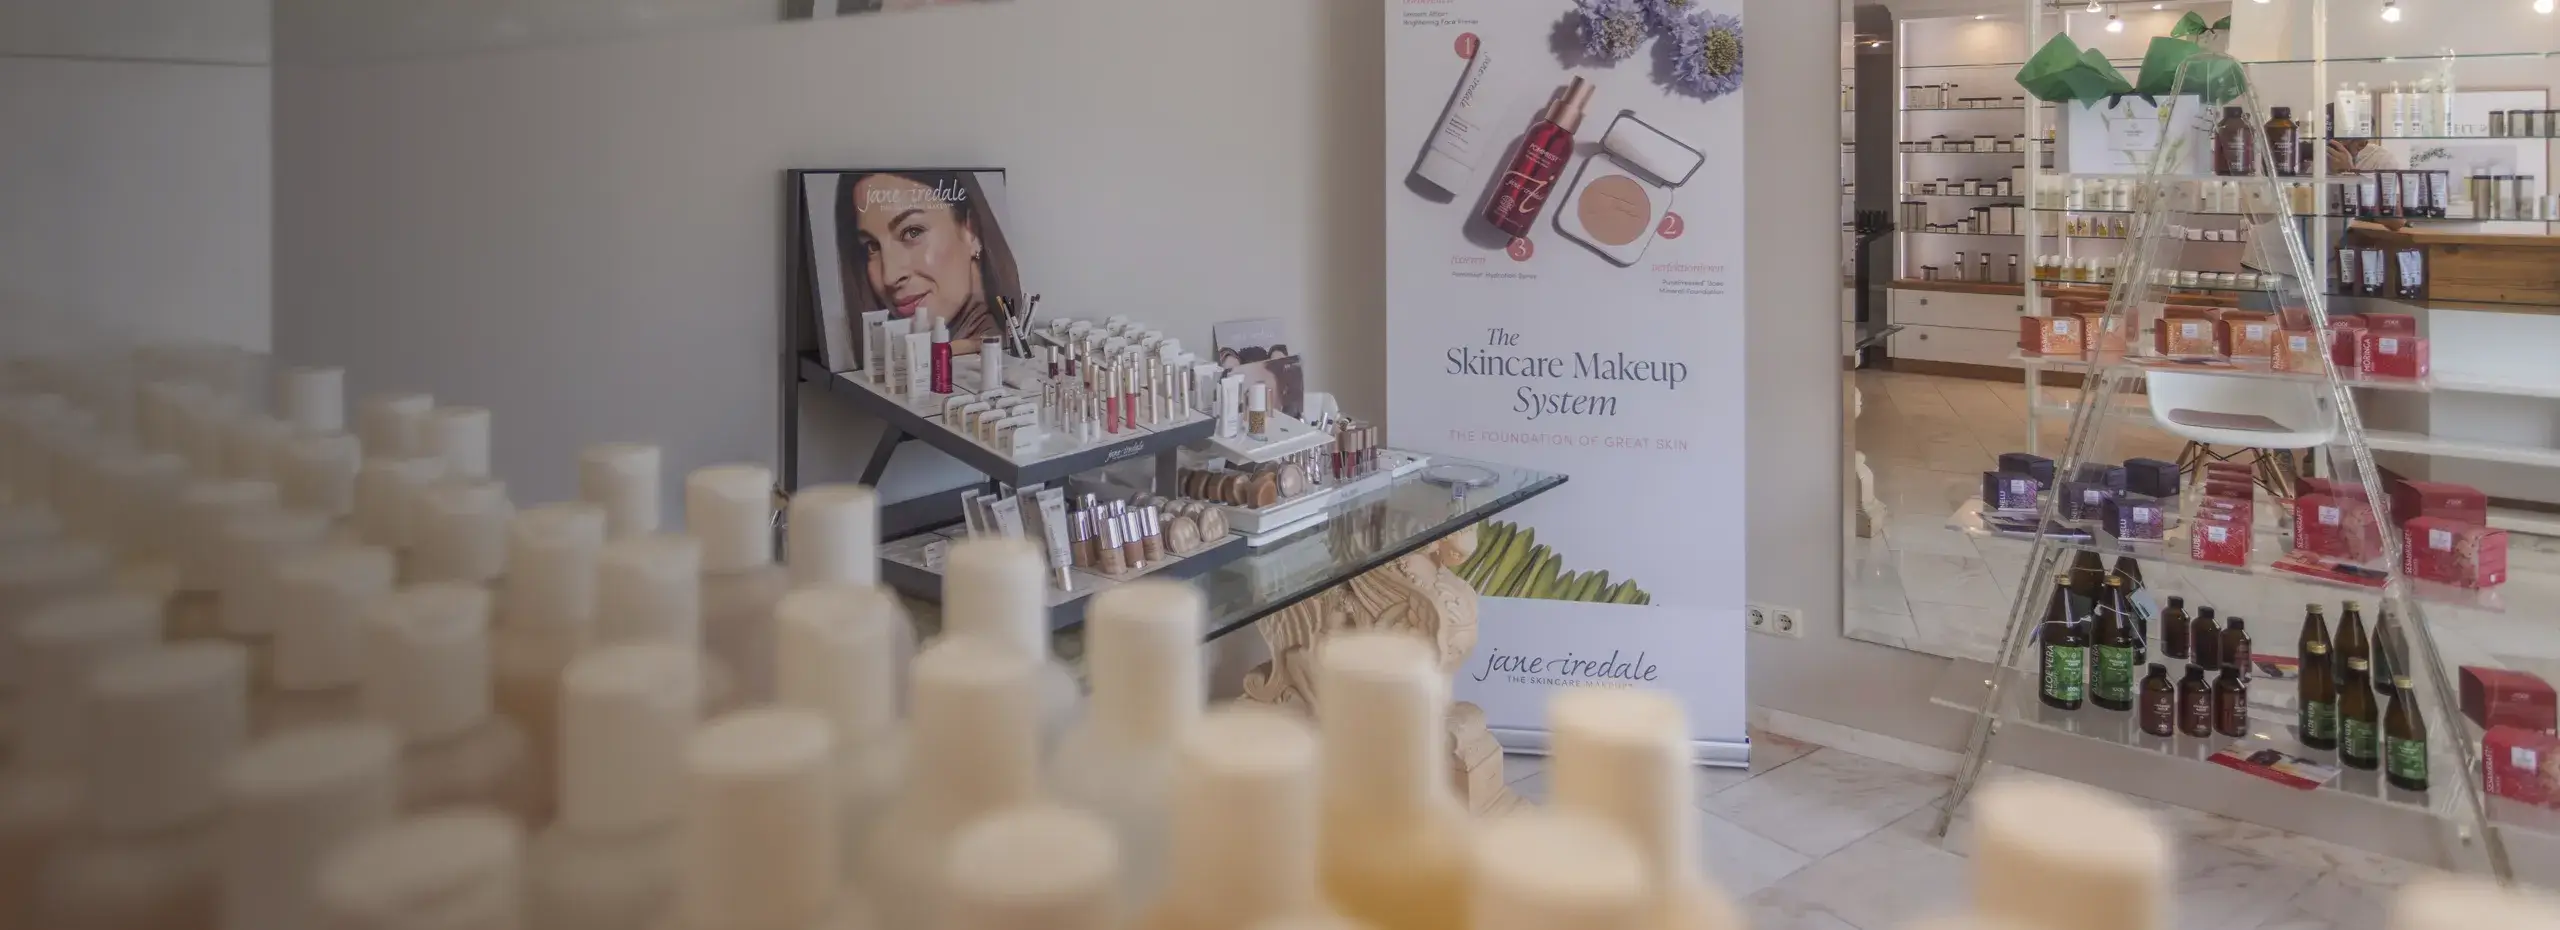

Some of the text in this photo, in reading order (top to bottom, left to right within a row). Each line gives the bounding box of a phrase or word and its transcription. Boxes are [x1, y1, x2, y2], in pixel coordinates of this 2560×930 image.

[858, 179, 967, 213] jane iredale
[1663, 215, 1677, 235] 2
[1514, 237, 1527, 257] 3
[1487, 328, 1520, 347] The
[1446, 347, 1688, 390] Skincare Makeup
[2272, 343, 2281, 369] PAPAYA
[2363, 339, 2371, 371] MORINGA
[1513, 386, 1617, 421] System
[1449, 429, 1688, 451] THE FOUNDATION OF GREAT SKIN
[1472, 648, 1658, 682] jane iredale
[2045, 645, 2054, 696] ALOE VERA
[1507, 676, 1526, 684] THE
[1530, 676, 1580, 687] SKINCARE
